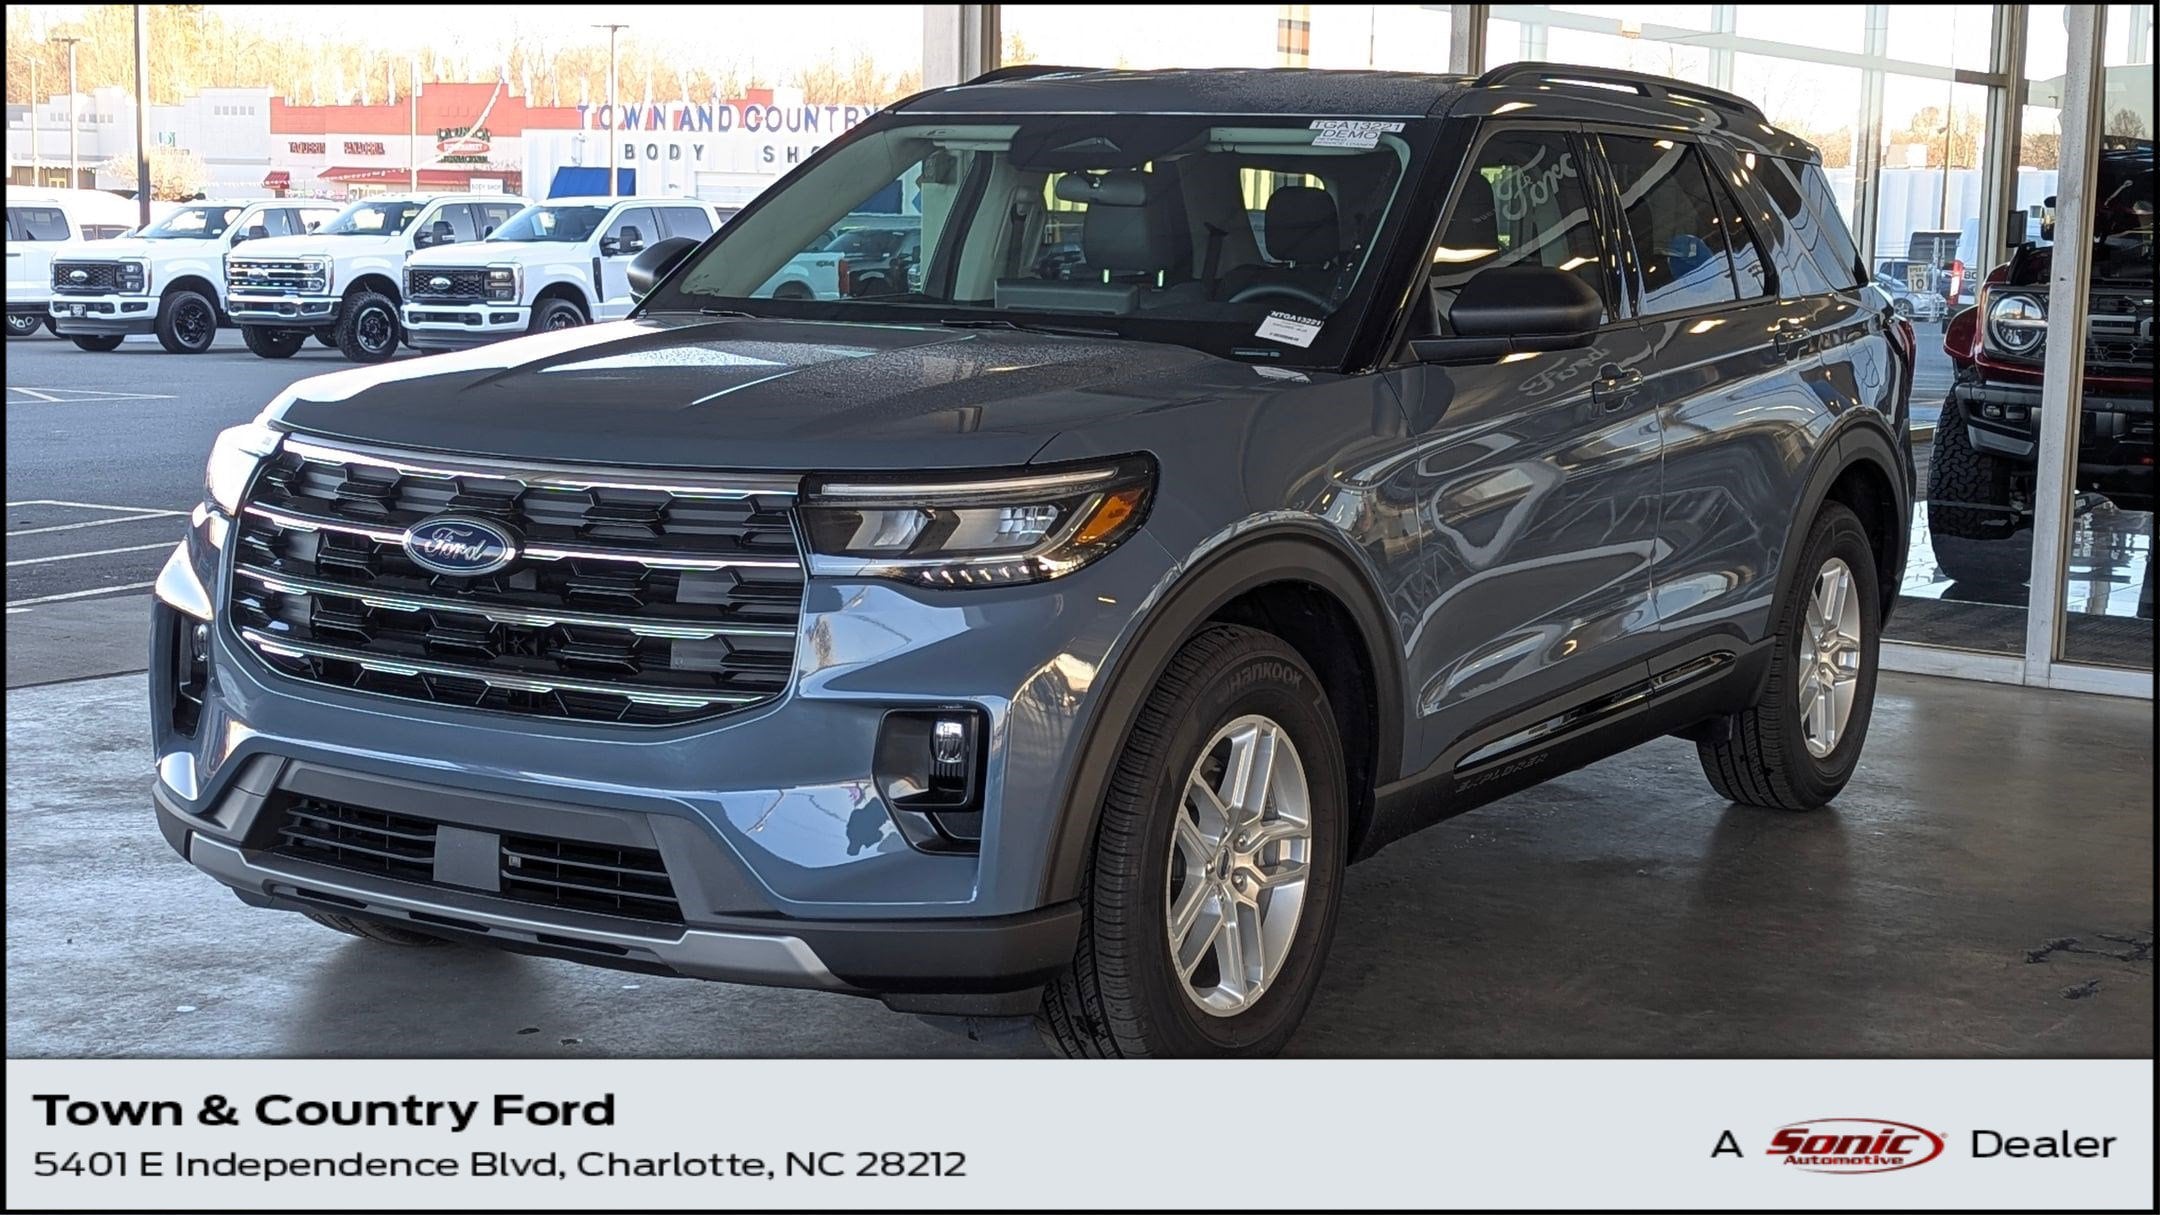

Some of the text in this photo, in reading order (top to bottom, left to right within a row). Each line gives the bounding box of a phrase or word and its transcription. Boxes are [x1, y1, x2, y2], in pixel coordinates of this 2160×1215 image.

[577, 104, 667, 131] TOWN
[679, 104, 732, 132] AND
[1322, 129, 1378, 140] DEMO
[624, 143, 705, 160] BODY
[1910, 278, 1925, 291] 10
[424, 527, 487, 561] Ford
